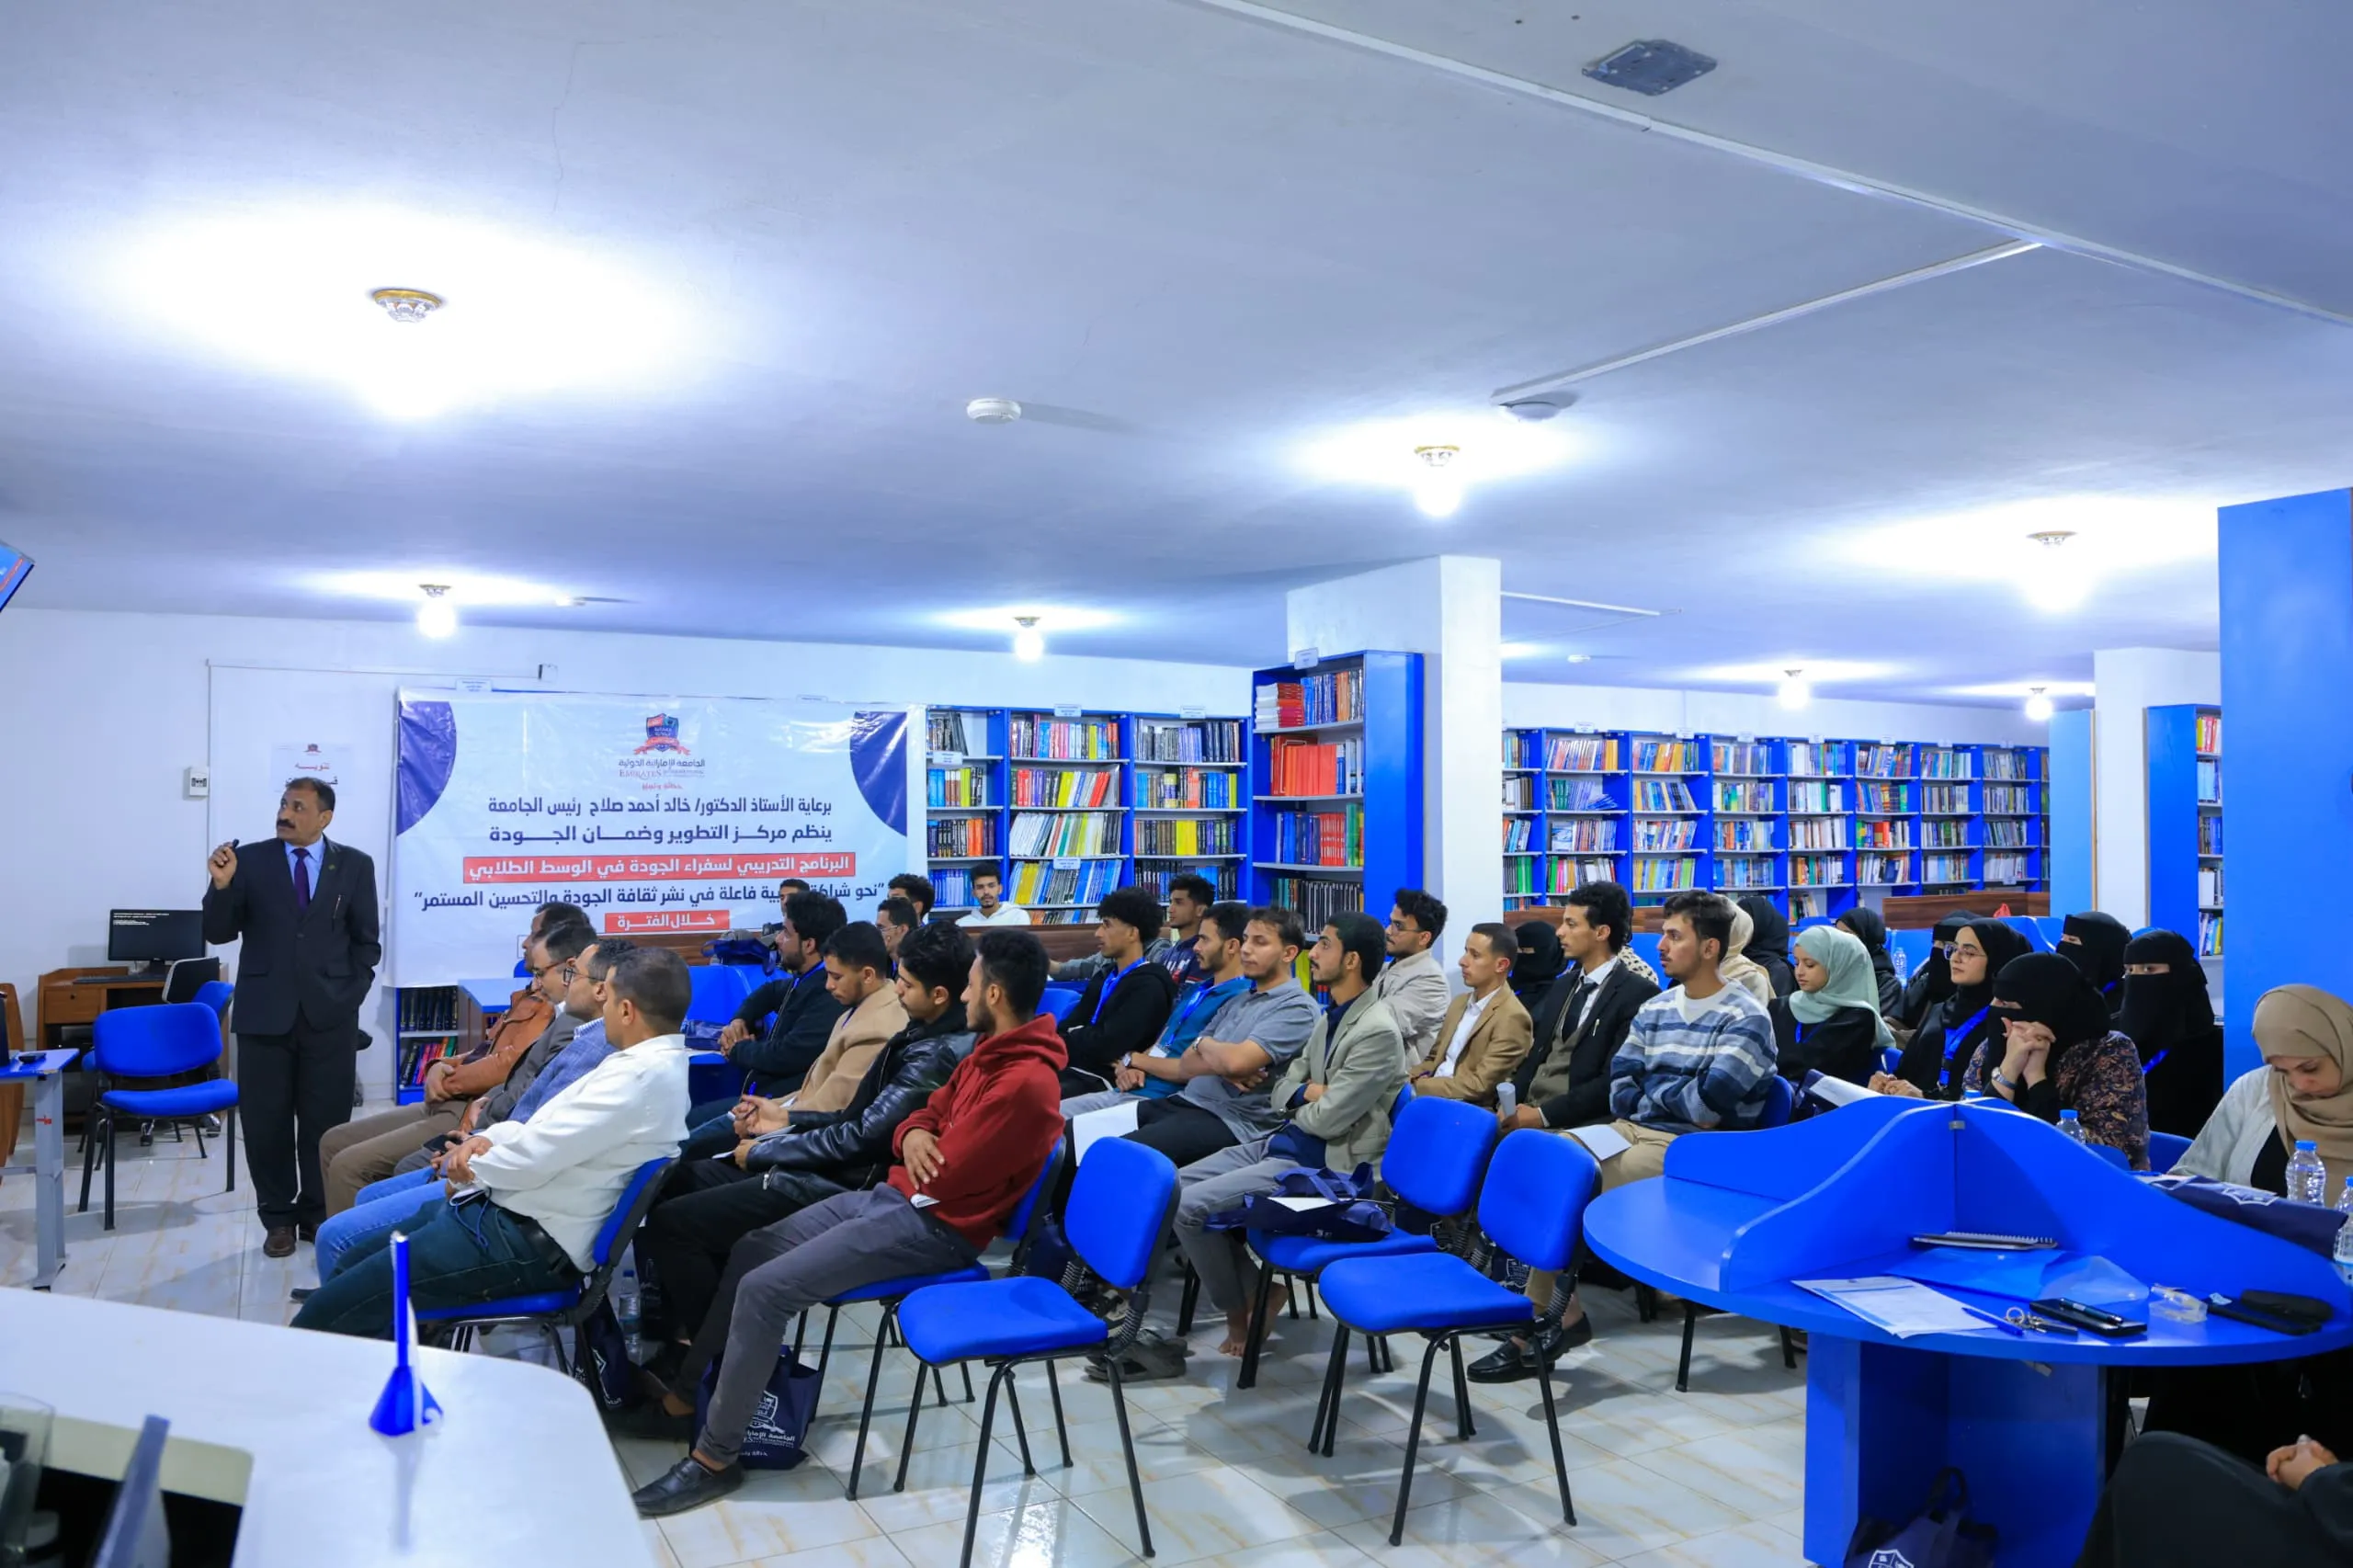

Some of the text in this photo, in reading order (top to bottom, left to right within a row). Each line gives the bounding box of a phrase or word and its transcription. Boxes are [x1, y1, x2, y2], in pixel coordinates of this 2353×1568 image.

[488, 797, 543, 817] الجامعة
[547, 797, 582, 817] رئيس
[589, 797, 624, 817] صلاح
[627, 793, 660, 813] أحمد
[664, 797, 691, 812] خالد
[750, 794, 794, 812] الأستاذ
[799, 797, 832, 816] برعاية
[667, 824, 729, 845] التطوير
[791, 824, 833, 844] ينظم
[469, 856, 849, 881] البرنامج التدريبي لسفراء الجودة في الوسط الطلابي
[563, 888, 612, 908] الجودة
[616, 887, 658, 903] ثقافة
[659, 886, 685, 906] نشر
[689, 887, 715, 908] في
[720, 885, 757, 901] فاعلة
